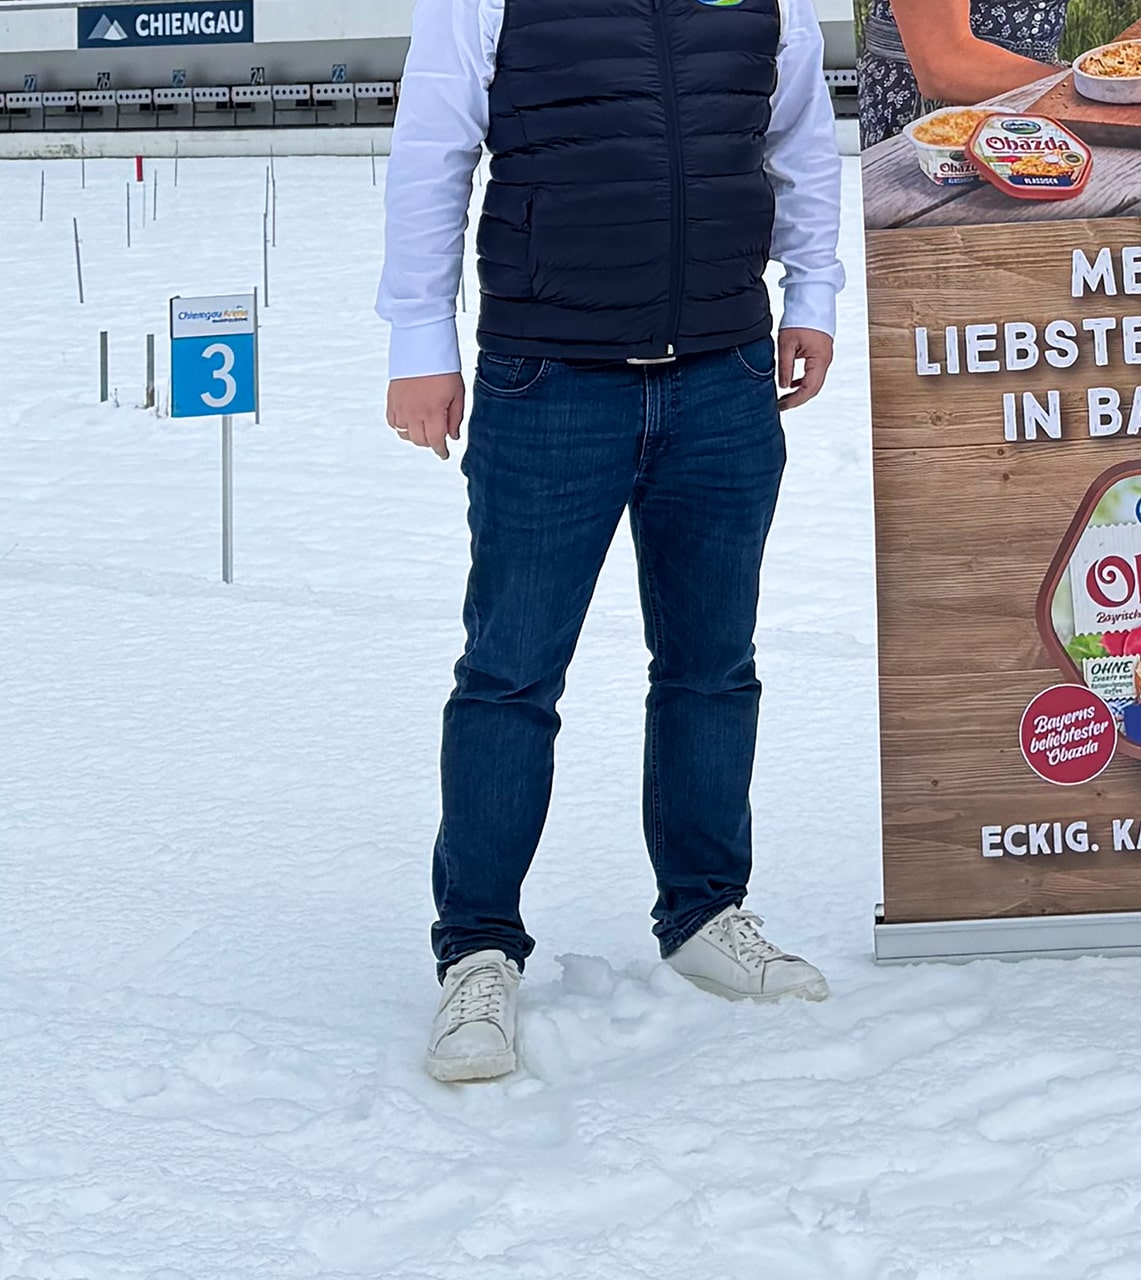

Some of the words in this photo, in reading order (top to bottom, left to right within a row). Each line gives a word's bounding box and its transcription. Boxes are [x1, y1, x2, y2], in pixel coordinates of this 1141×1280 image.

[135, 9, 245, 38] CHIEMGAU
[252, 68, 265, 84] 24
[985, 136, 1071, 151] Obazda
[200, 342, 238, 408] 3
[1002, 389, 1063, 442] IN
[1091, 661, 1133, 675] OHNE
[1033, 706, 1096, 734] Bayerns
[1030, 720, 1109, 754] beliebtester
[1045, 740, 1099, 766] Obazda
[981, 821, 1099, 857] ECKIG.
